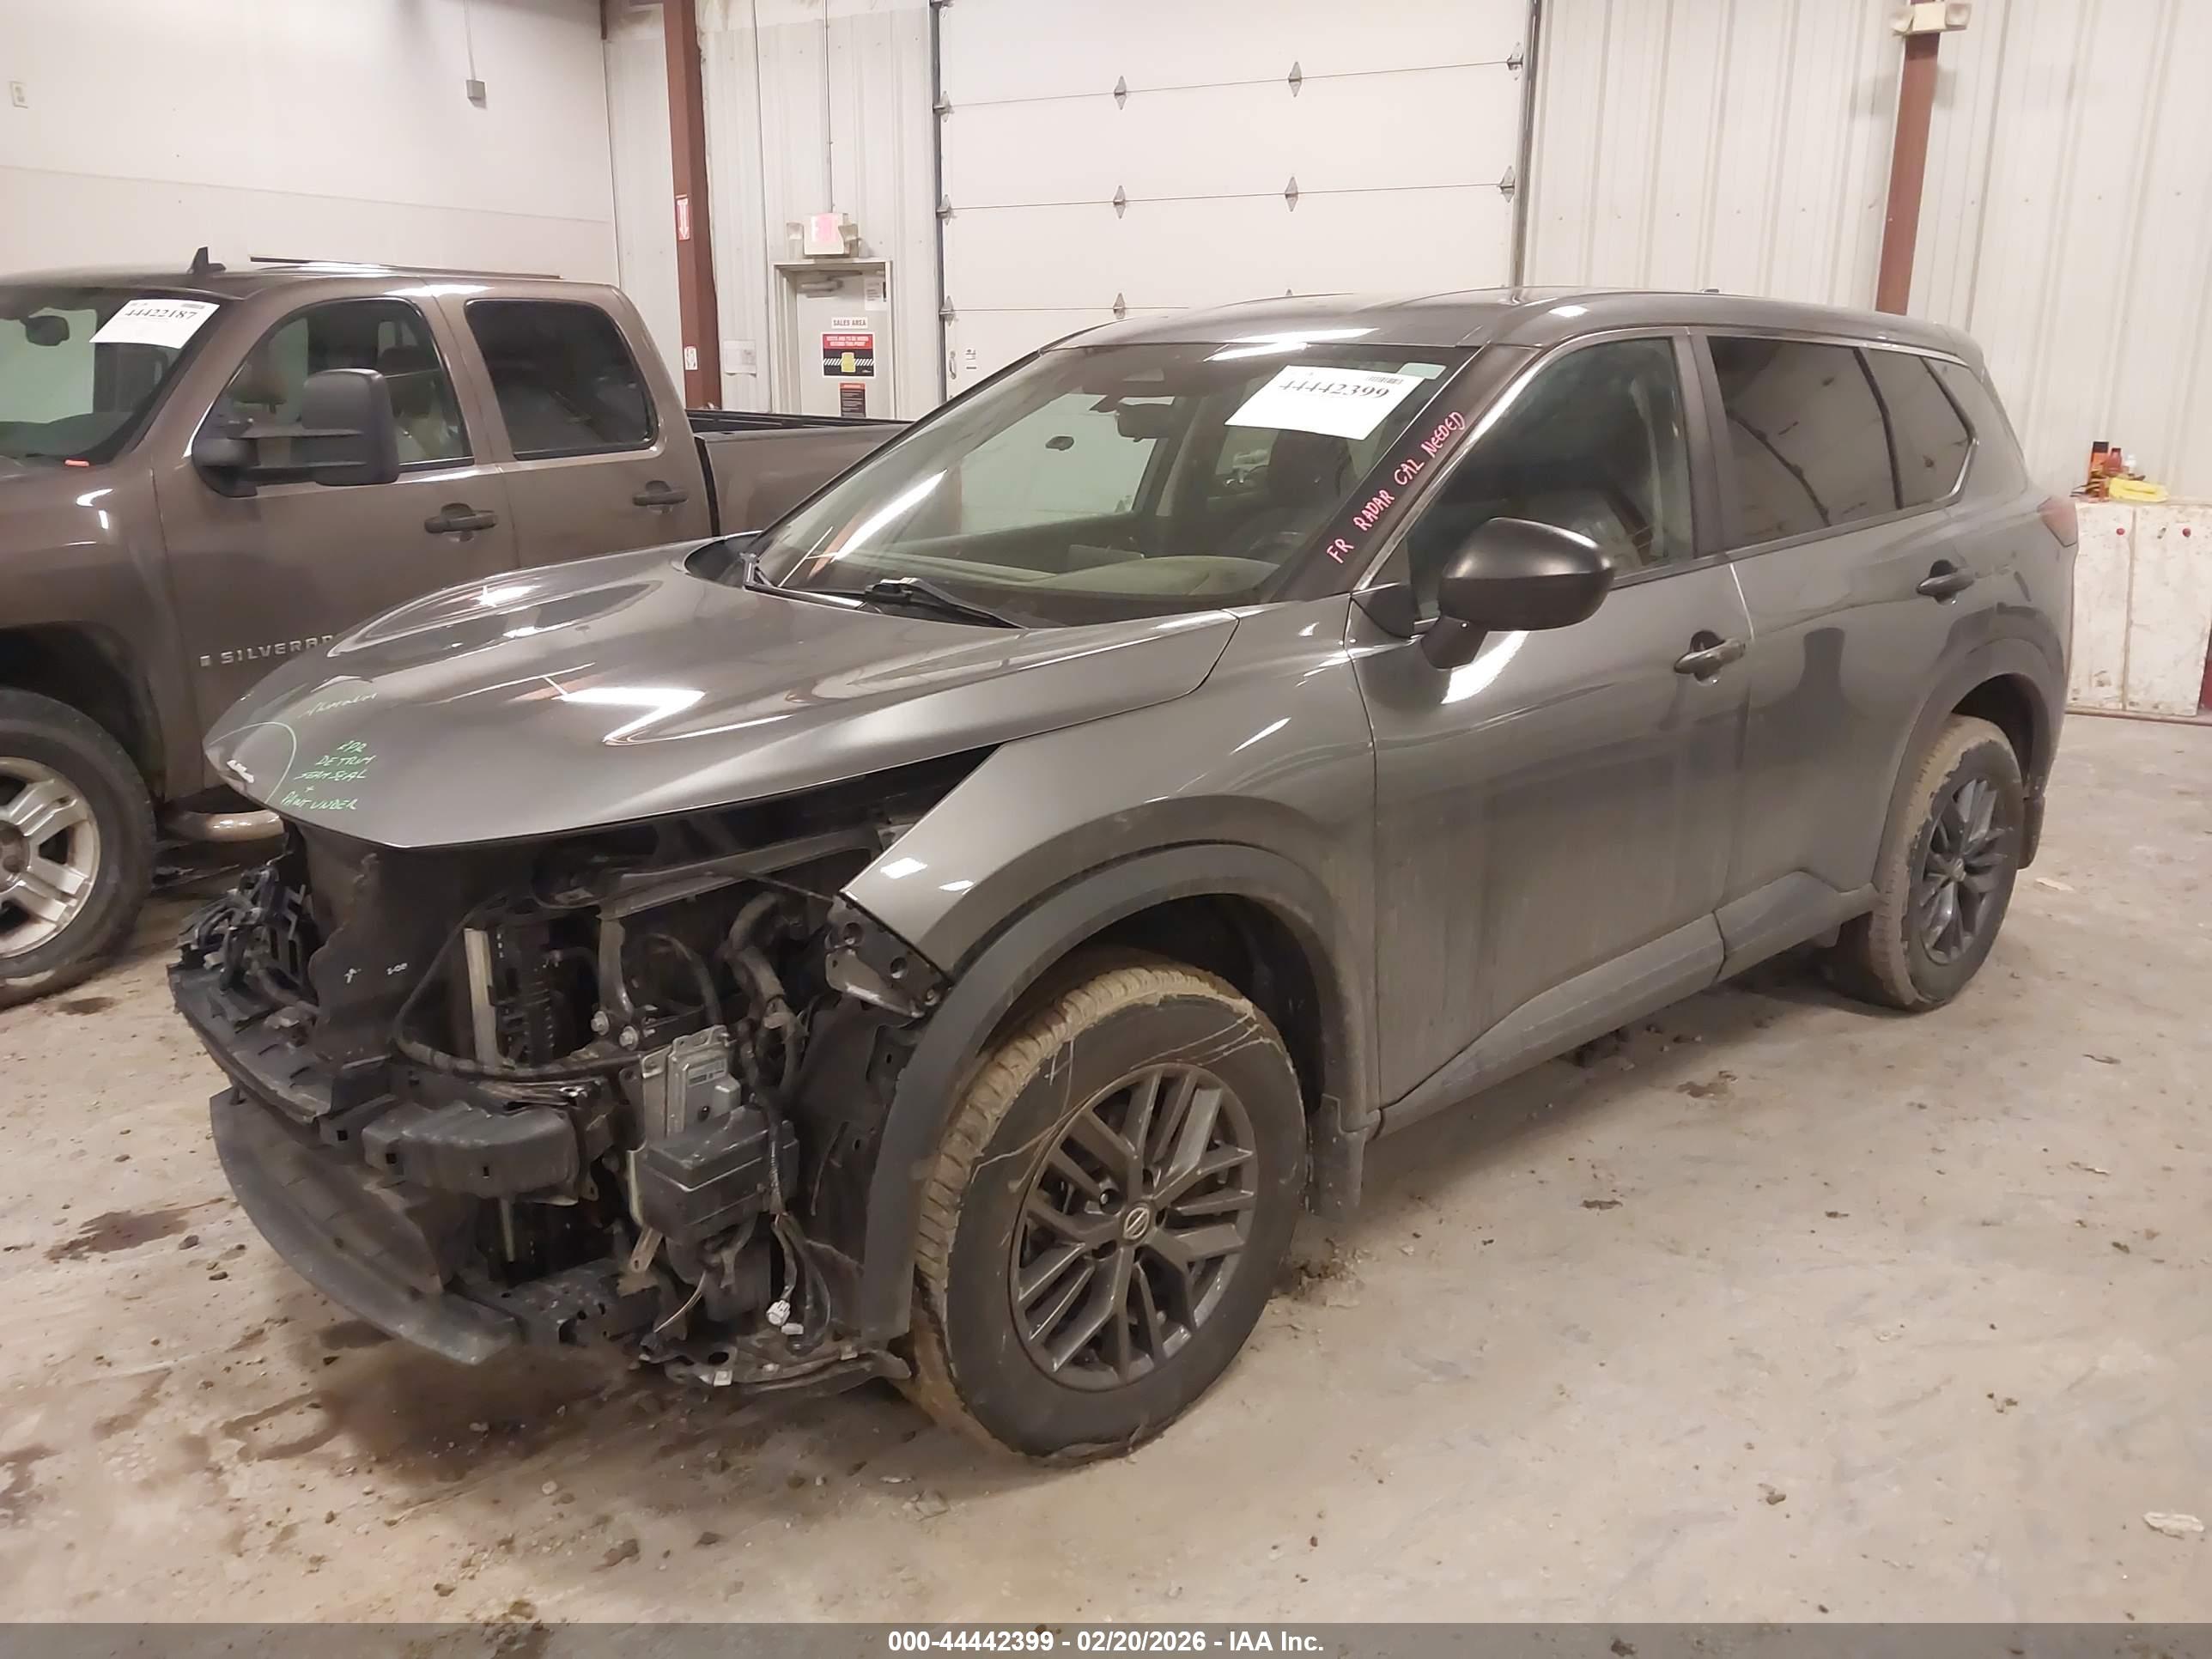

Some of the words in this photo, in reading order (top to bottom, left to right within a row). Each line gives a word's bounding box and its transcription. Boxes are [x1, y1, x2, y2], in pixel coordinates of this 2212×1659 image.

[125, 308, 198, 319] 44422187
[1279, 380, 1390, 398] 44442399
[1327, 538, 1355, 564] FR
[1352, 489, 1395, 531] RADAR
[1394, 459, 1425, 486] CAL
